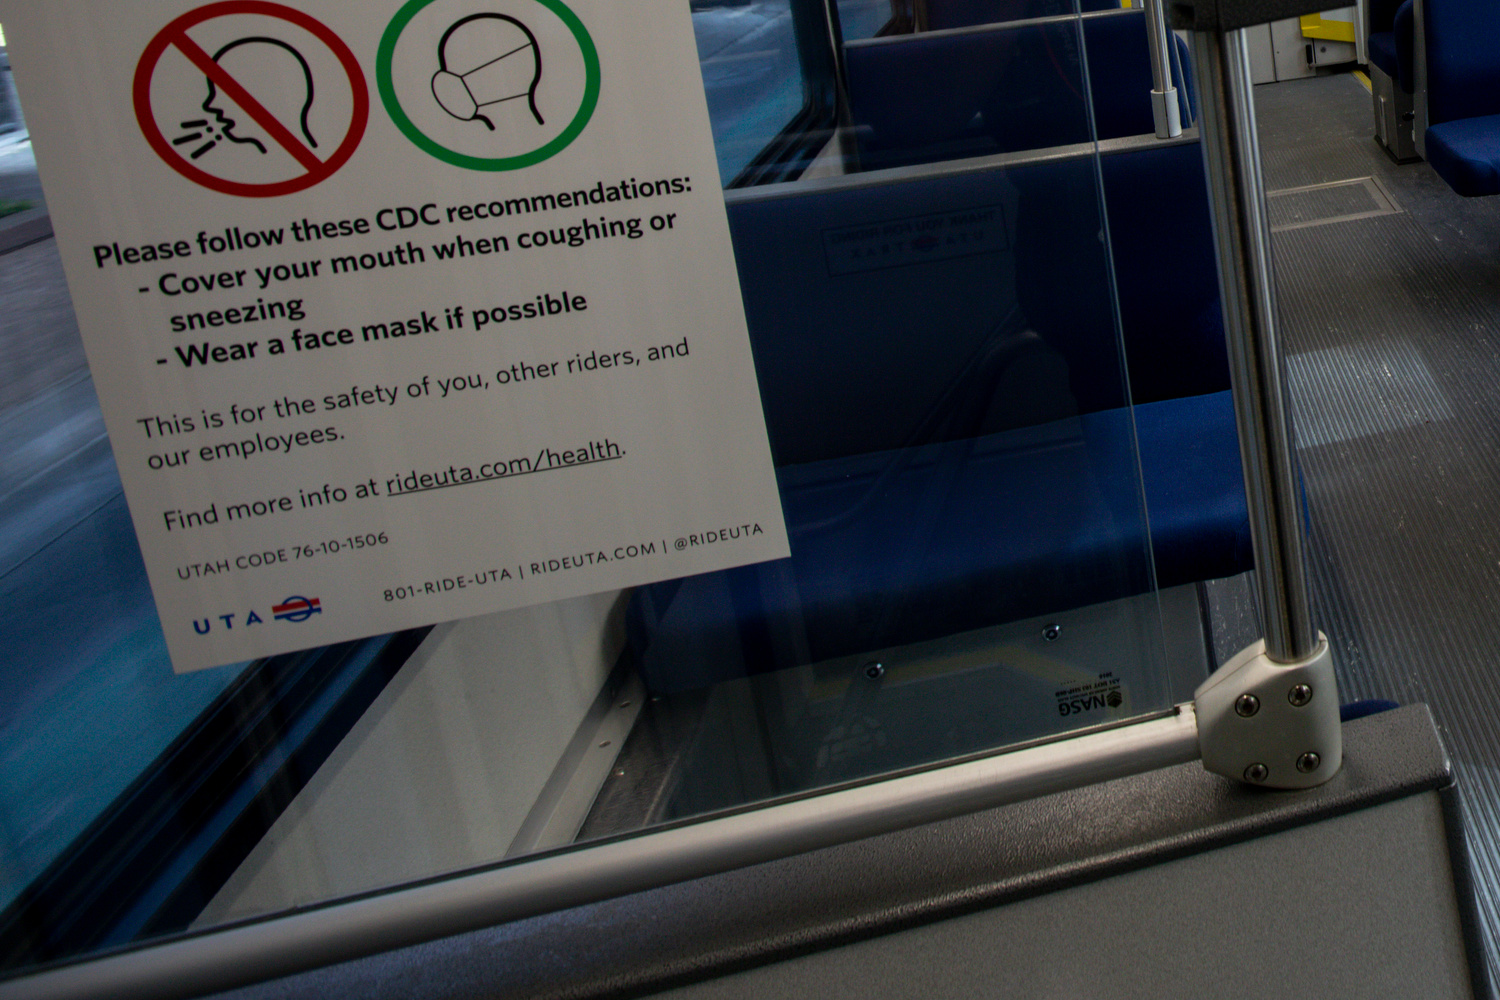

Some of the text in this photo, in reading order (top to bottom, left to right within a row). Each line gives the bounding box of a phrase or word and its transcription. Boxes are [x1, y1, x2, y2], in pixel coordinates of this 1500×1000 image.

[93, 177, 691, 268] Please follow these CDC recommendations:
[159, 270, 246, 296] Cover
[255, 260, 321, 289] your
[331, 241, 425, 274] mouth
[432, 235, 509, 260] when
[517, 217, 643, 249] coughing
[650, 213, 676, 231] or
[170, 298, 306, 332] sneezing
[174, 341, 258, 367] Wear
[268, 338, 285, 355] a
[291, 328, 354, 351] face
[362, 311, 439, 342] mask
[445, 306, 464, 330] if
[472, 291, 587, 331] possible
[137, 337, 689, 438] This is for the safety of you, other riders, and
[148, 427, 344, 469] our employees.
[164, 439, 625, 531] Find more info at rideuta.com/health.
[177, 532, 388, 580] UTAH CODE 76-10-1506
[384, 568, 512, 602] 801-RIDE-UTA
[531, 542, 655, 575] RIDEUTA.COM
[674, 523, 763, 551] @RIDEUTA
[193, 610, 263, 635] UTA
[1058, 694, 1105, 716] NASG
